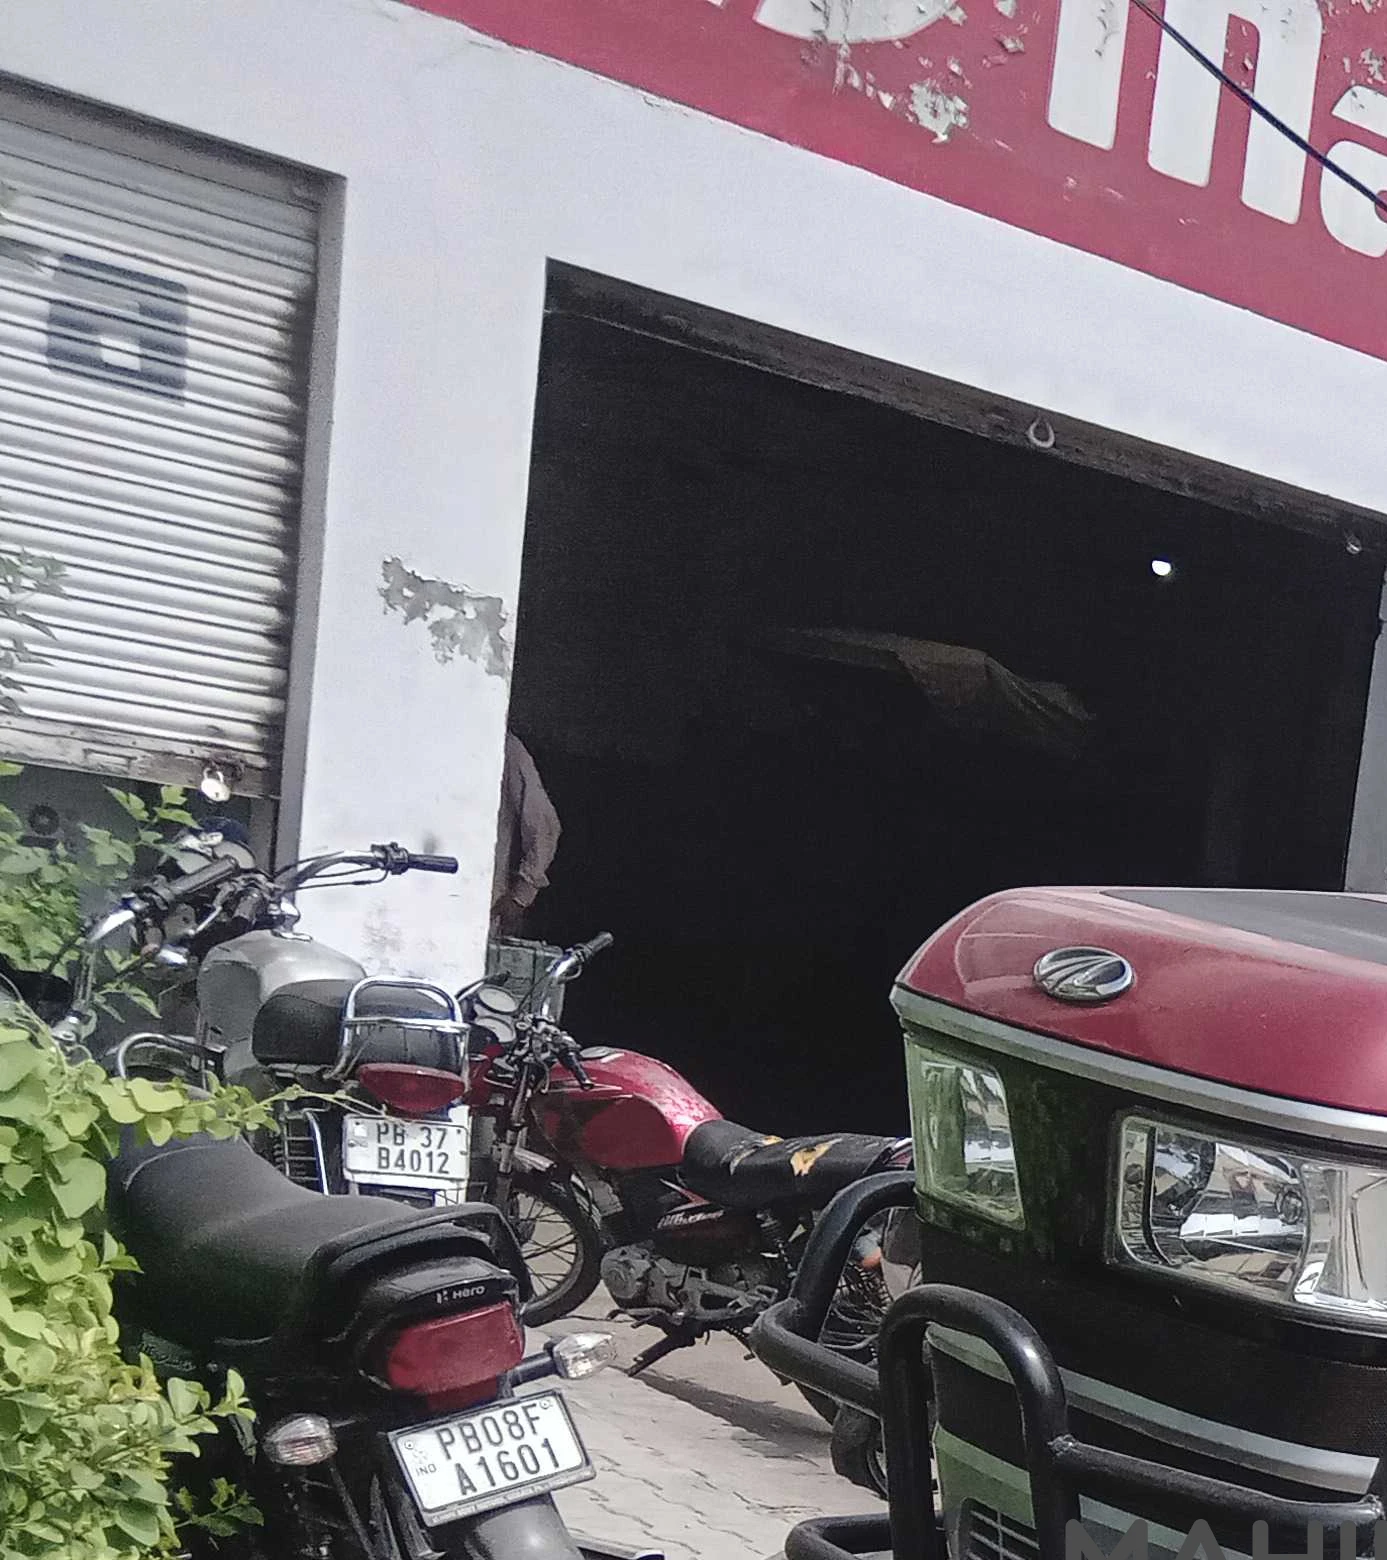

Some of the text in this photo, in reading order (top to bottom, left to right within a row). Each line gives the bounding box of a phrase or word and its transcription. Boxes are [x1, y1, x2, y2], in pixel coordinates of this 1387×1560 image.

[377, 1122, 449, 1150] PB 37
[378, 1147, 450, 1175] B4012
[452, 1284, 487, 1300] Hero
[435, 1401, 543, 1463] PB08F
[413, 1462, 438, 1479] IND
[453, 1437, 562, 1498] A1601
